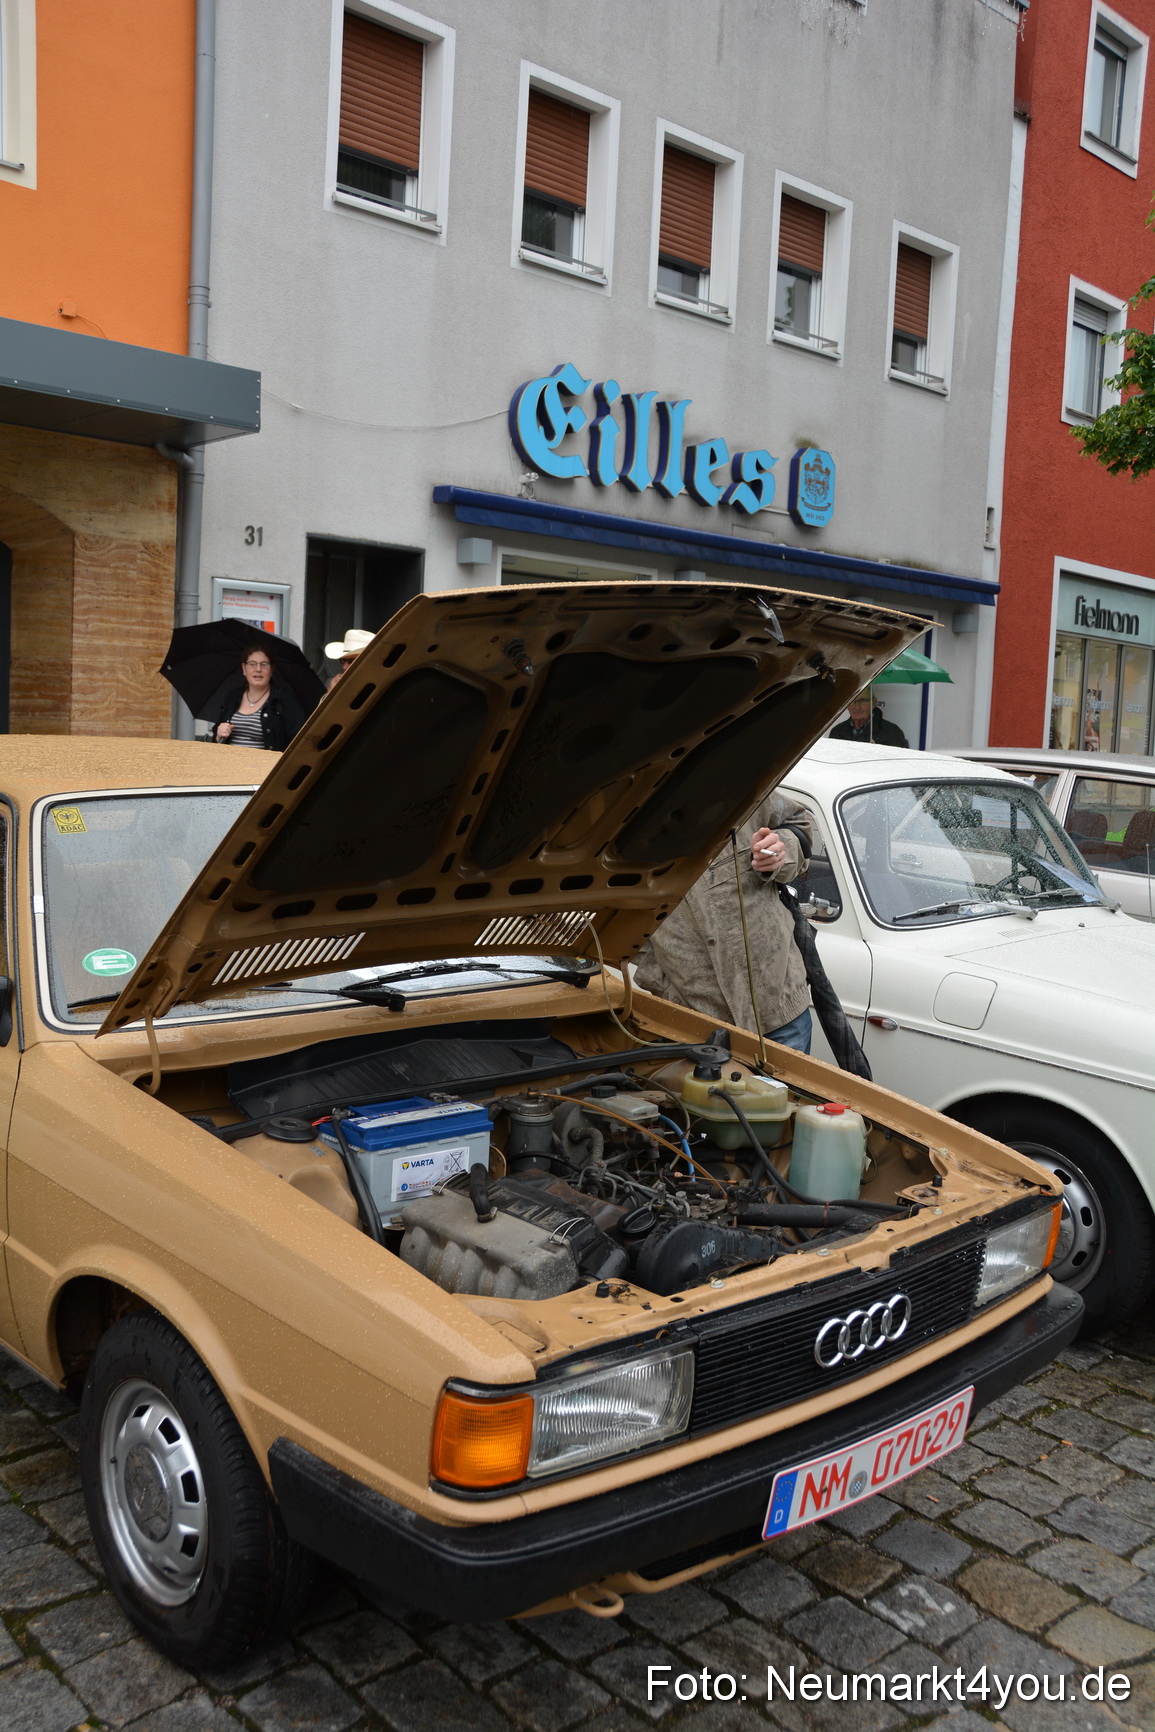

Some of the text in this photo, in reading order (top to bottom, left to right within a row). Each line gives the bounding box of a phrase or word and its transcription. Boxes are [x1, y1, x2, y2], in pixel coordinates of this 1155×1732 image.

[510, 362, 779, 514] Eilles
[244, 525, 263, 547] 31
[1074, 595, 1140, 635] fielmann
[60, 824, 84, 832] ADAC
[92, 954, 130, 970] E
[411, 1158, 434, 1168] VARTA
[701, 1240, 716, 1259] 306
[798, 1400, 966, 1518] NM 07029
[774, 1509, 784, 1525] D
